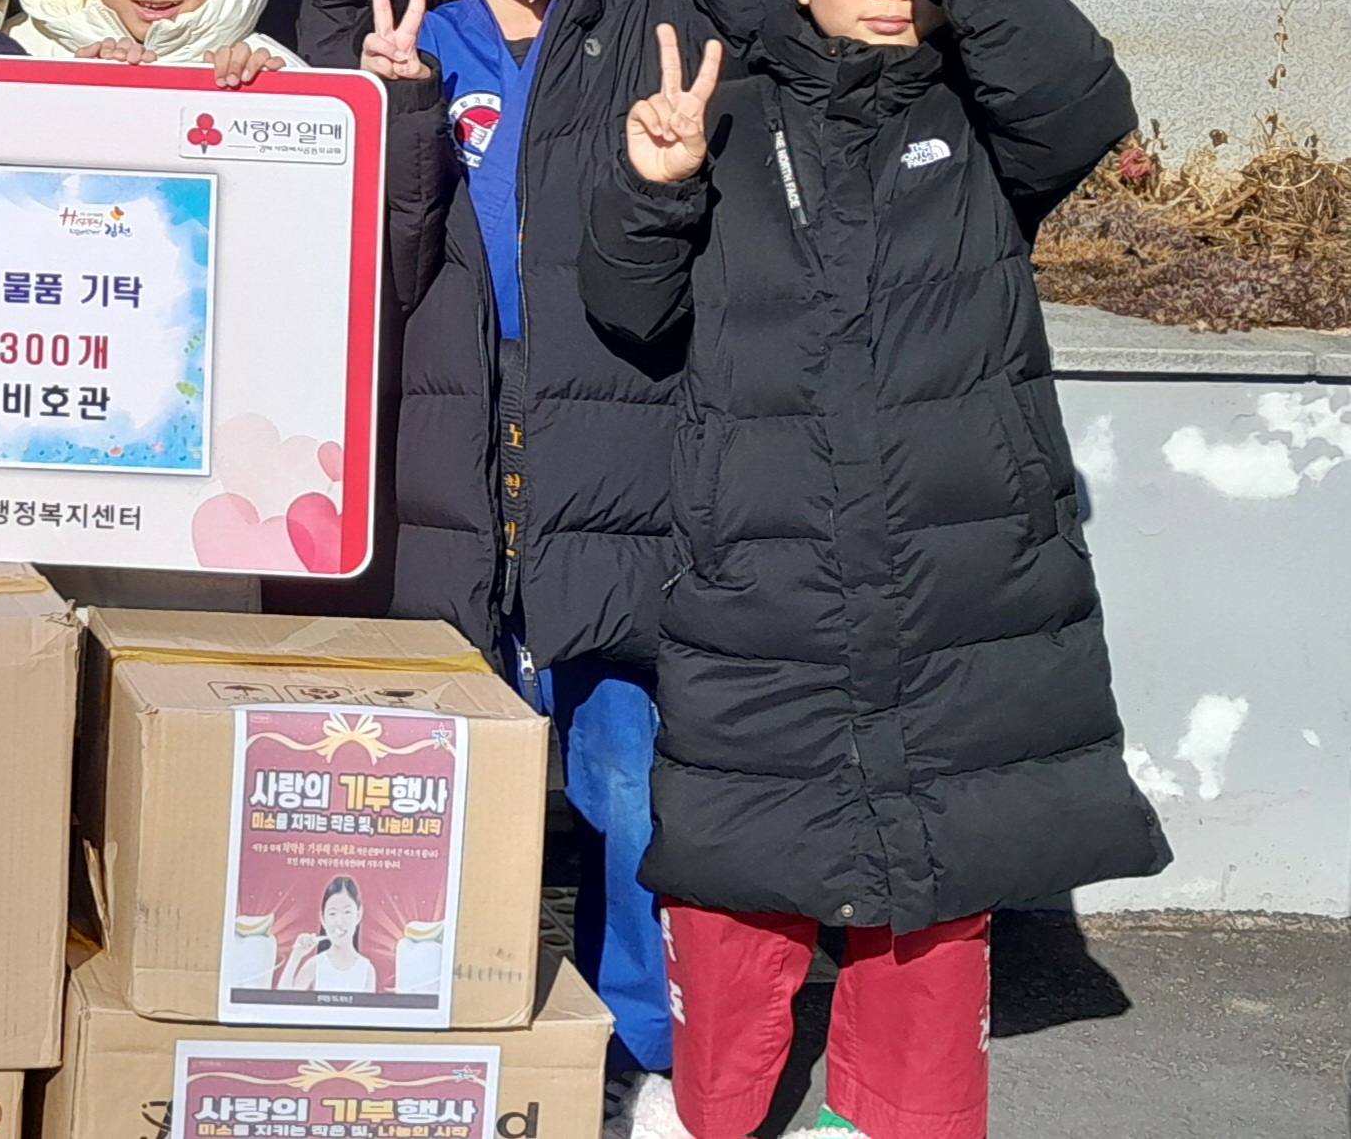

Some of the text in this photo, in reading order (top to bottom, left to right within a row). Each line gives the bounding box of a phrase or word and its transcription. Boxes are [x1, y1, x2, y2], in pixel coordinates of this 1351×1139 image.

[228, 120, 291, 143] 사랑의
[908, 141, 930, 153] THE
[3, 271, 63, 306] 물품
[81, 274, 143, 309] 기탁
[0, 332, 109, 370] 300개
[250, 771, 448, 814] 사랑의 기부행사
[251, 812, 287, 830] 미소를
[290, 813, 328, 832] 지키는
[330, 814, 355, 833] 작은
[377, 815, 413, 834] 나눔의
[416, 817, 441, 835] 시작
[193, 1097, 476, 1125] 사랑의 기부행사
[255, 1124, 307, 1138] 지키는
[311, 1125, 346, 1139] 작은
[434, 1126, 469, 1139] 시작
